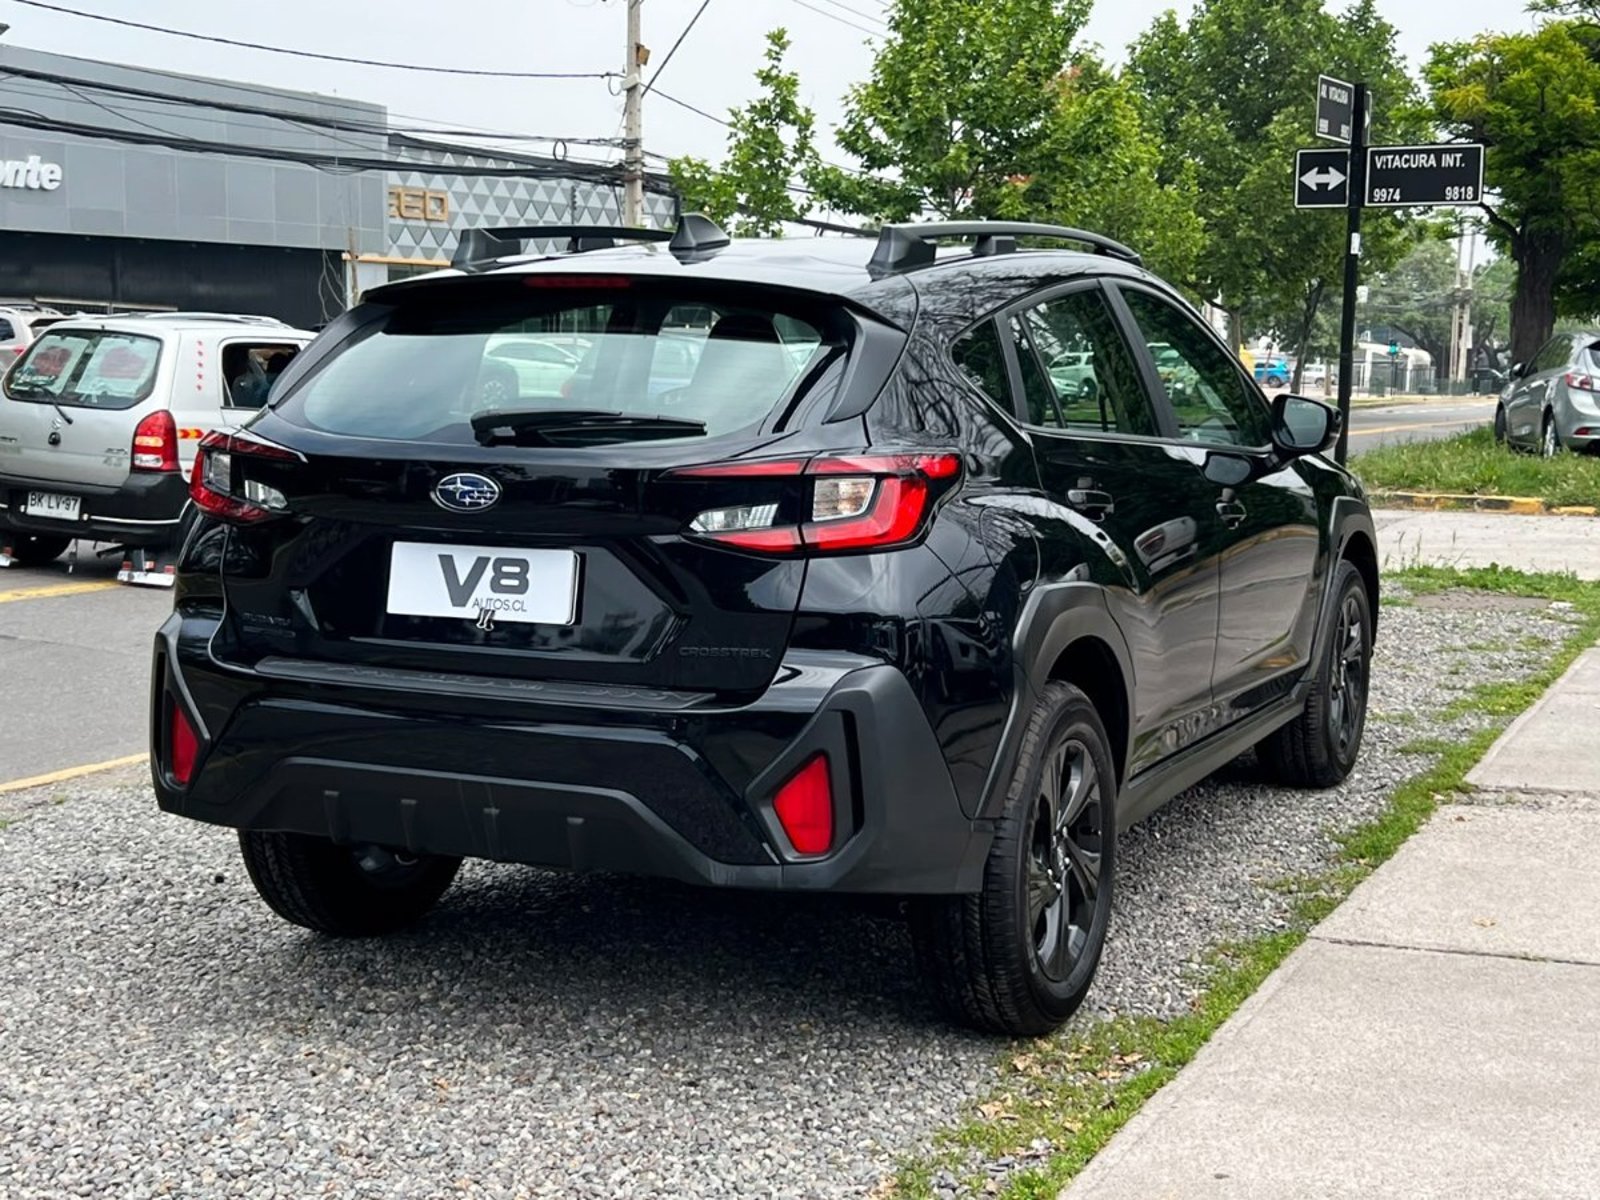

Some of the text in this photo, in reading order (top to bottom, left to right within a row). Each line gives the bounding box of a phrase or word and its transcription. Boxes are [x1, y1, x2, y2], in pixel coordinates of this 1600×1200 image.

[1375, 153, 1465, 169] VITACURA INT.
[0, 155, 62, 190] nte
[1373, 186, 1473, 202] 9974 9818
[438, 554, 530, 607] V8
[471, 597, 527, 612] AUTOS.CL
[679, 646, 772, 659] CROSSTREK
